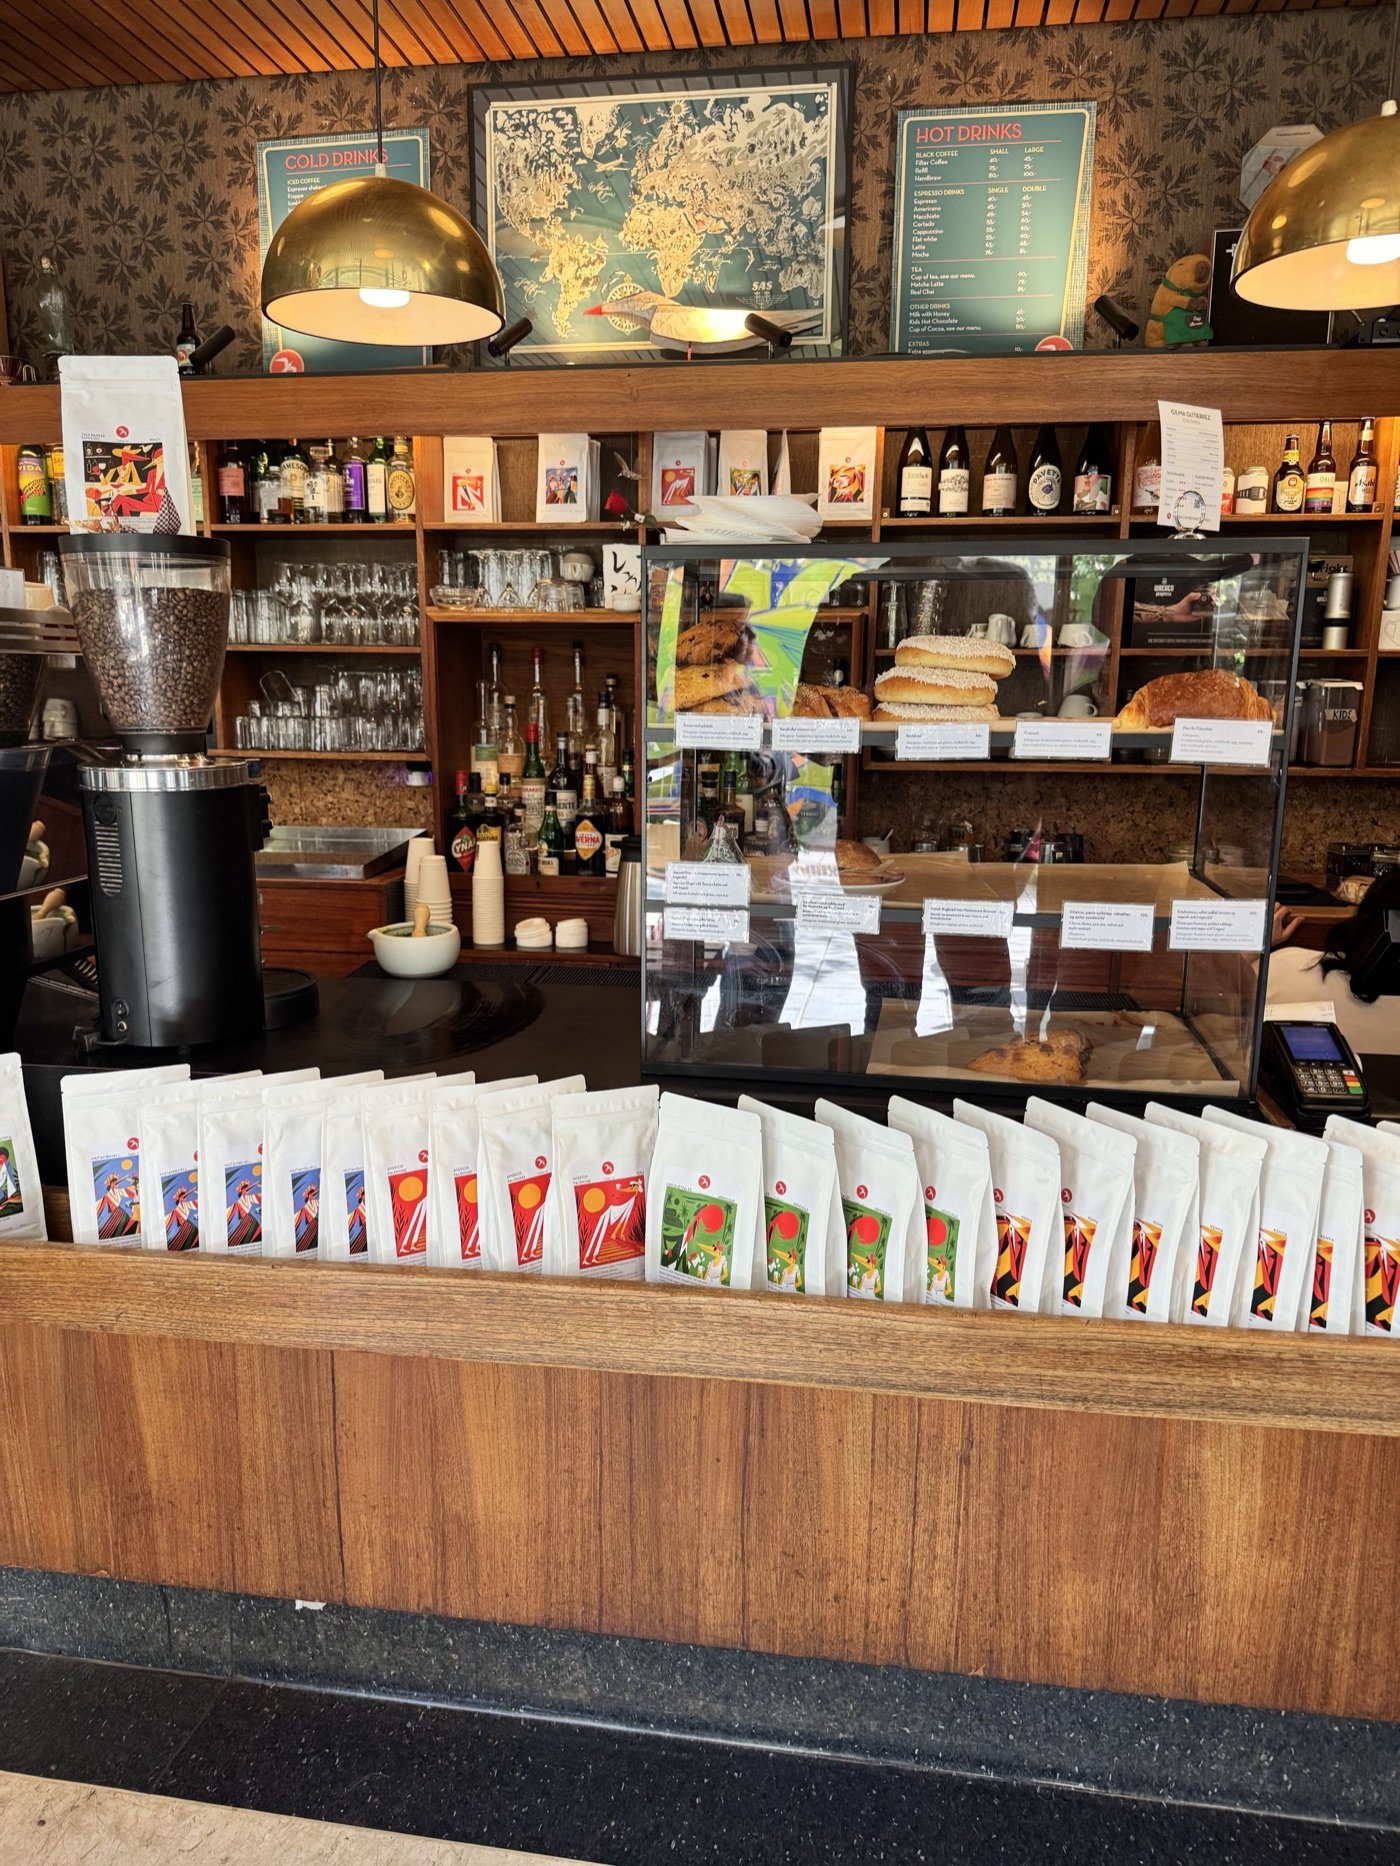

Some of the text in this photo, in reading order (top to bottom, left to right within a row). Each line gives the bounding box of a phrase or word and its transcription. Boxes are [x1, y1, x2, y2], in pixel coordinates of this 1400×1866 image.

[915, 124, 1022, 143] HOT DRINKS
[935, 150, 959, 158] COFFEE
[1024, 146, 1044, 154] LARGE
[285, 148, 388, 170] COLD DRINKS
[930, 158, 948, 166] Coffee
[914, 174, 942, 182] Handbrew
[944, 188, 965, 196] DRINKS
[988, 186, 1008, 194] SINGLE
[914, 198, 938, 206] Espresso
[912, 228, 944, 236] Cappuccino
[910, 274, 922, 282] Cup
[752, 281, 773, 291] SAS
[930, 280, 944, 288] Latte
[930, 302, 950, 310] DRINKS
[932, 310, 950, 318] Honey
[909, 318, 920, 326] Kids
[908, 340, 930, 348] EXTRAS
